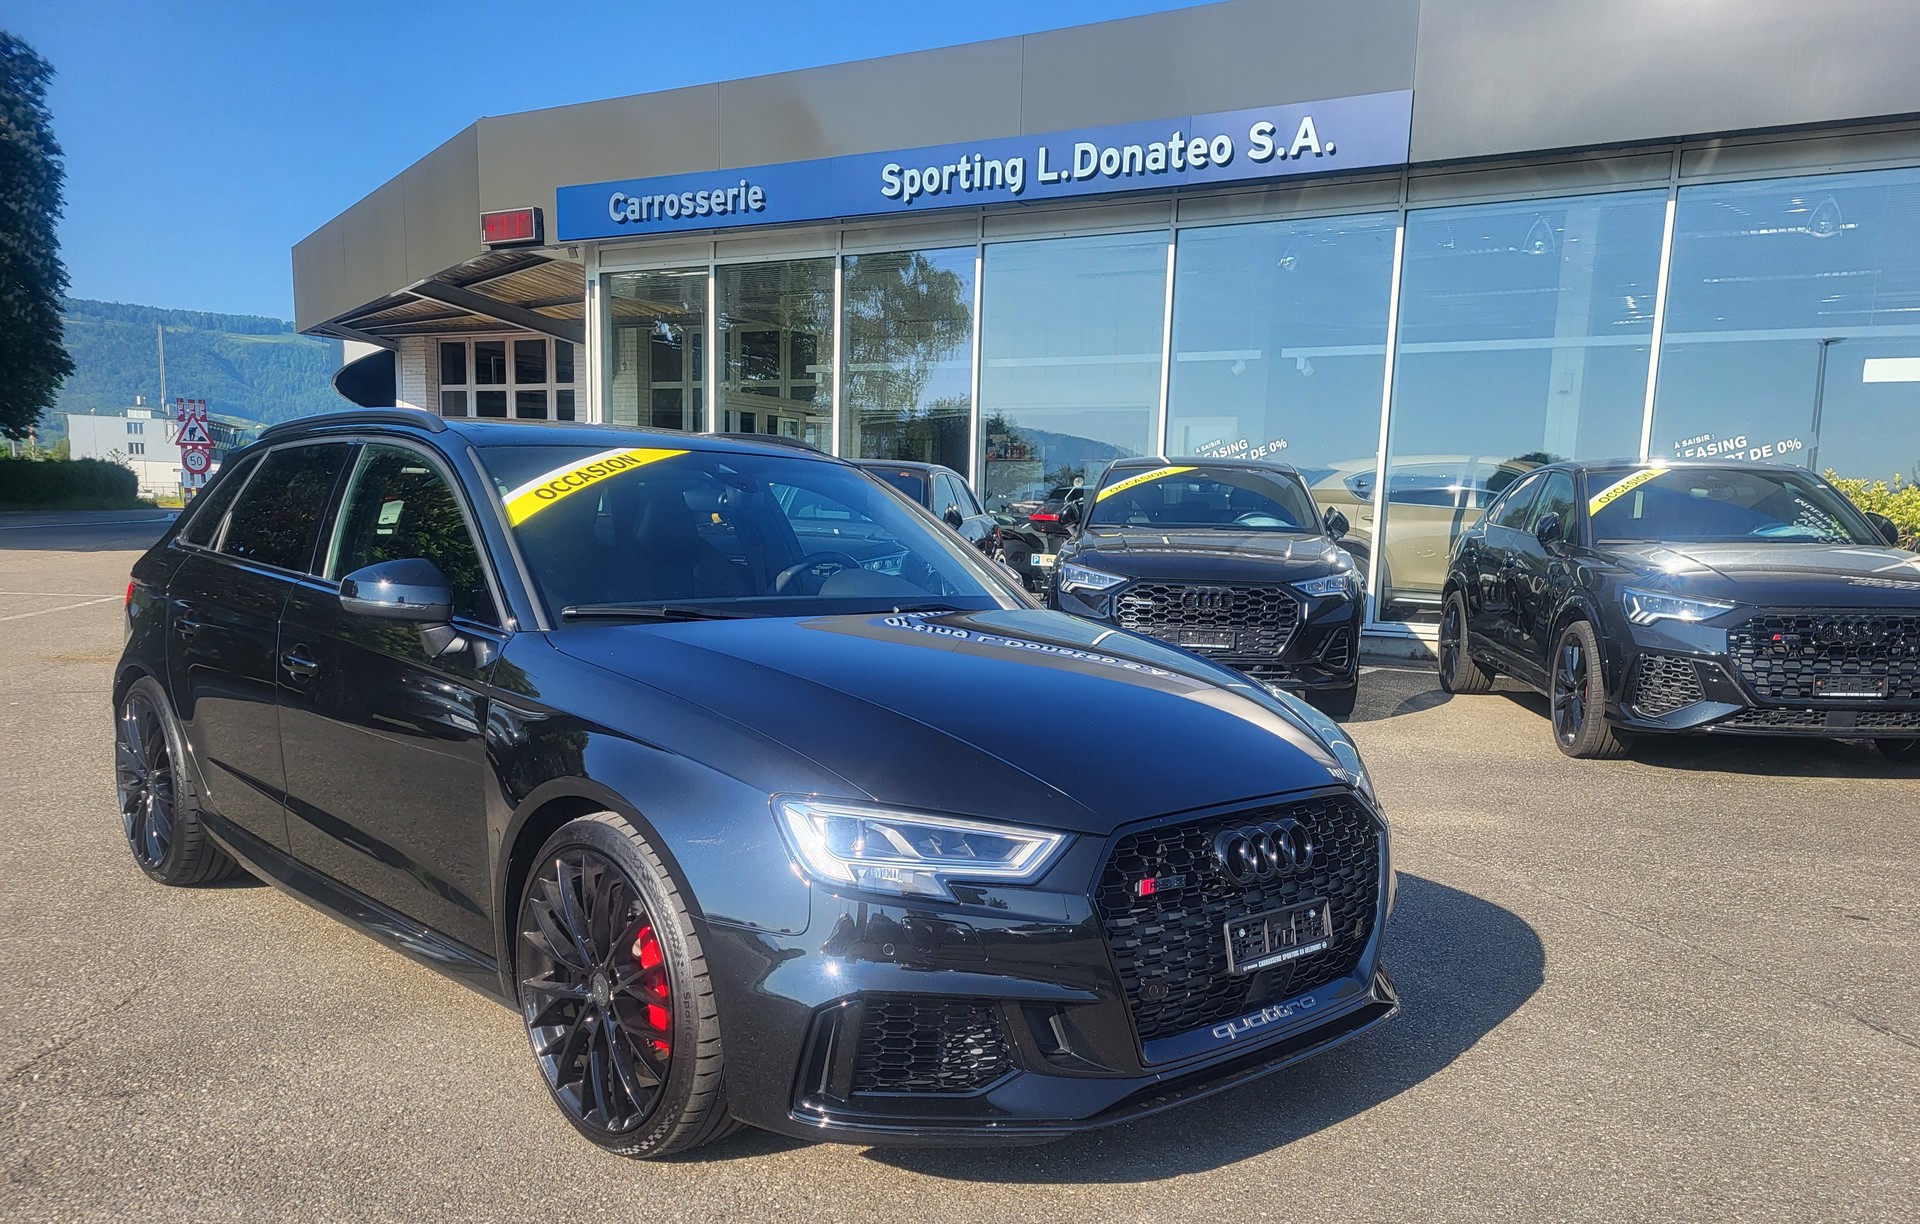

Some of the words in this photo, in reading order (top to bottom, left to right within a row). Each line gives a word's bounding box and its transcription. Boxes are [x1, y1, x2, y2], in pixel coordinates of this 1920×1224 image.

[881, 153, 1024, 203] Sporting
[1038, 130, 1233, 182] L.Donateo
[1247, 116, 1337, 159] S.A.
[608, 179, 766, 223] Carrosserie
[1251, 445, 1268, 460] DE
[1269, 438, 1288, 453] 0%
[1681, 434, 1711, 447] SAISIR
[1749, 444, 1774, 461] DE
[1777, 438, 1802, 454] 0%
[190, 456, 203, 467] 50
[534, 454, 641, 500] OCCASION
[1109, 470, 1168, 493] OCCASION
[1598, 471, 1656, 504] OCCASION
[1213, 995, 1317, 1040] quattro
